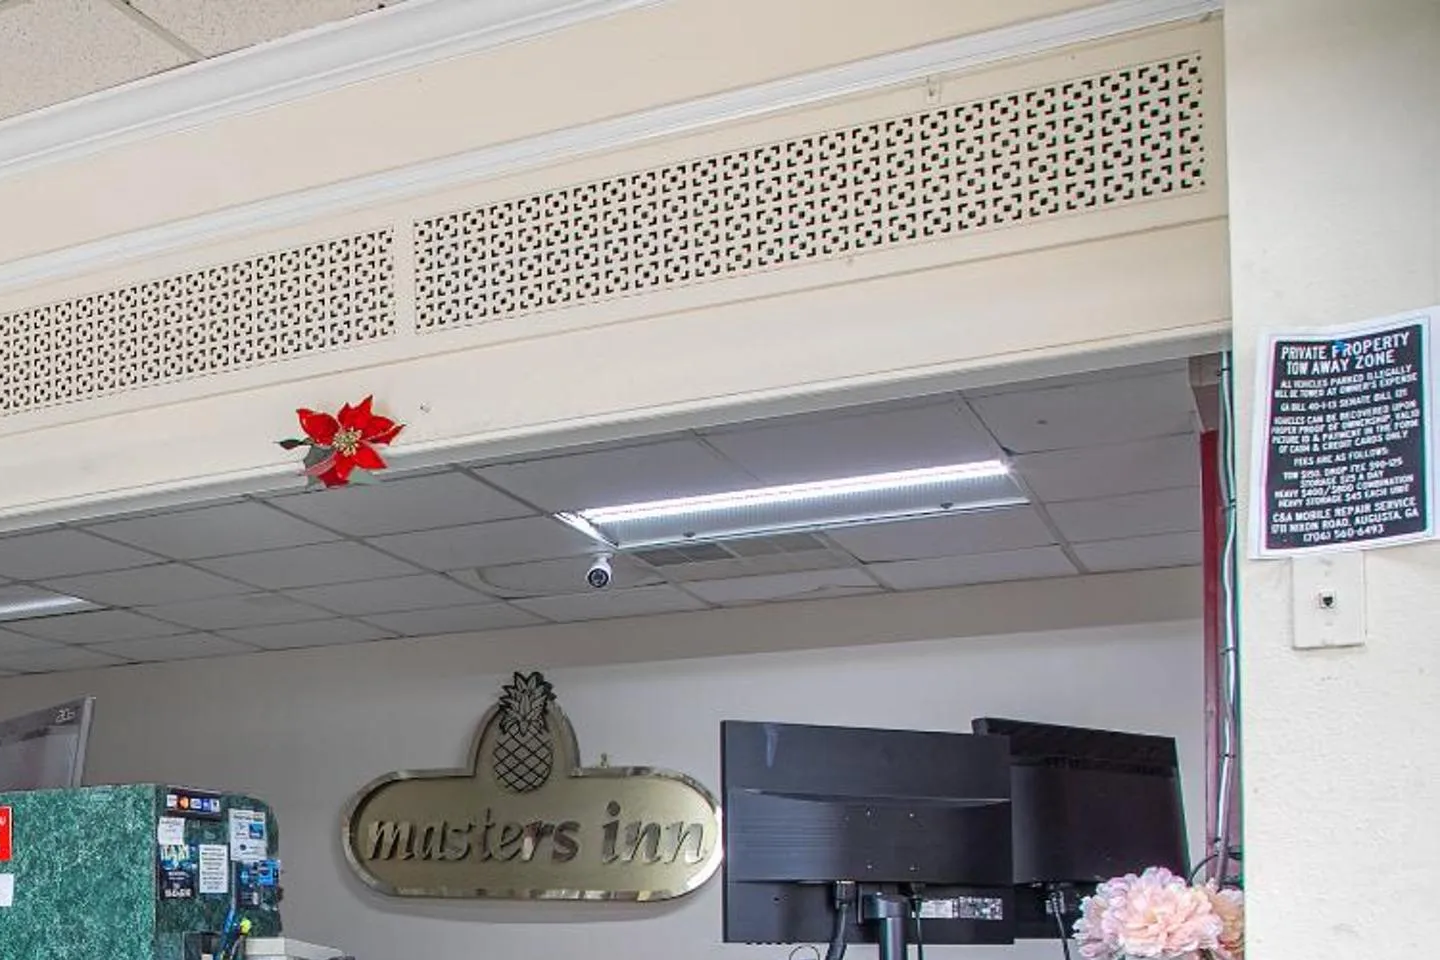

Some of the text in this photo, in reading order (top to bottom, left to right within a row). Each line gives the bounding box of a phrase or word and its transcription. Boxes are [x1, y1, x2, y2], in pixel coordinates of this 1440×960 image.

[1281, 331, 1410, 360] PRIVATE PROPERTY
[1287, 348, 1396, 375] TOW AWAY ZONE
[1326, 386, 1337, 396] AT
[1379, 371, 1418, 388] EXPENSE
[1330, 373, 1364, 387] PARKED
[1366, 364, 1412, 381] ILLEGALLY
[1298, 423, 1325, 434] PROOF
[1307, 414, 1324, 425] CAN
[1322, 427, 1362, 442] PAYMENT
[1355, 434, 1383, 447] CARDS
[1384, 429, 1409, 441] ONLY
[1334, 452, 1347, 462] AS
[1366, 469, 1384, 481] DAY
[1295, 508, 1332, 522] MOBILE
[1333, 502, 1372, 518] REPAIR
[1373, 495, 1417, 512] SERVICE
[1404, 507, 1420, 519] GA
[366, 800, 704, 865] masters inn
